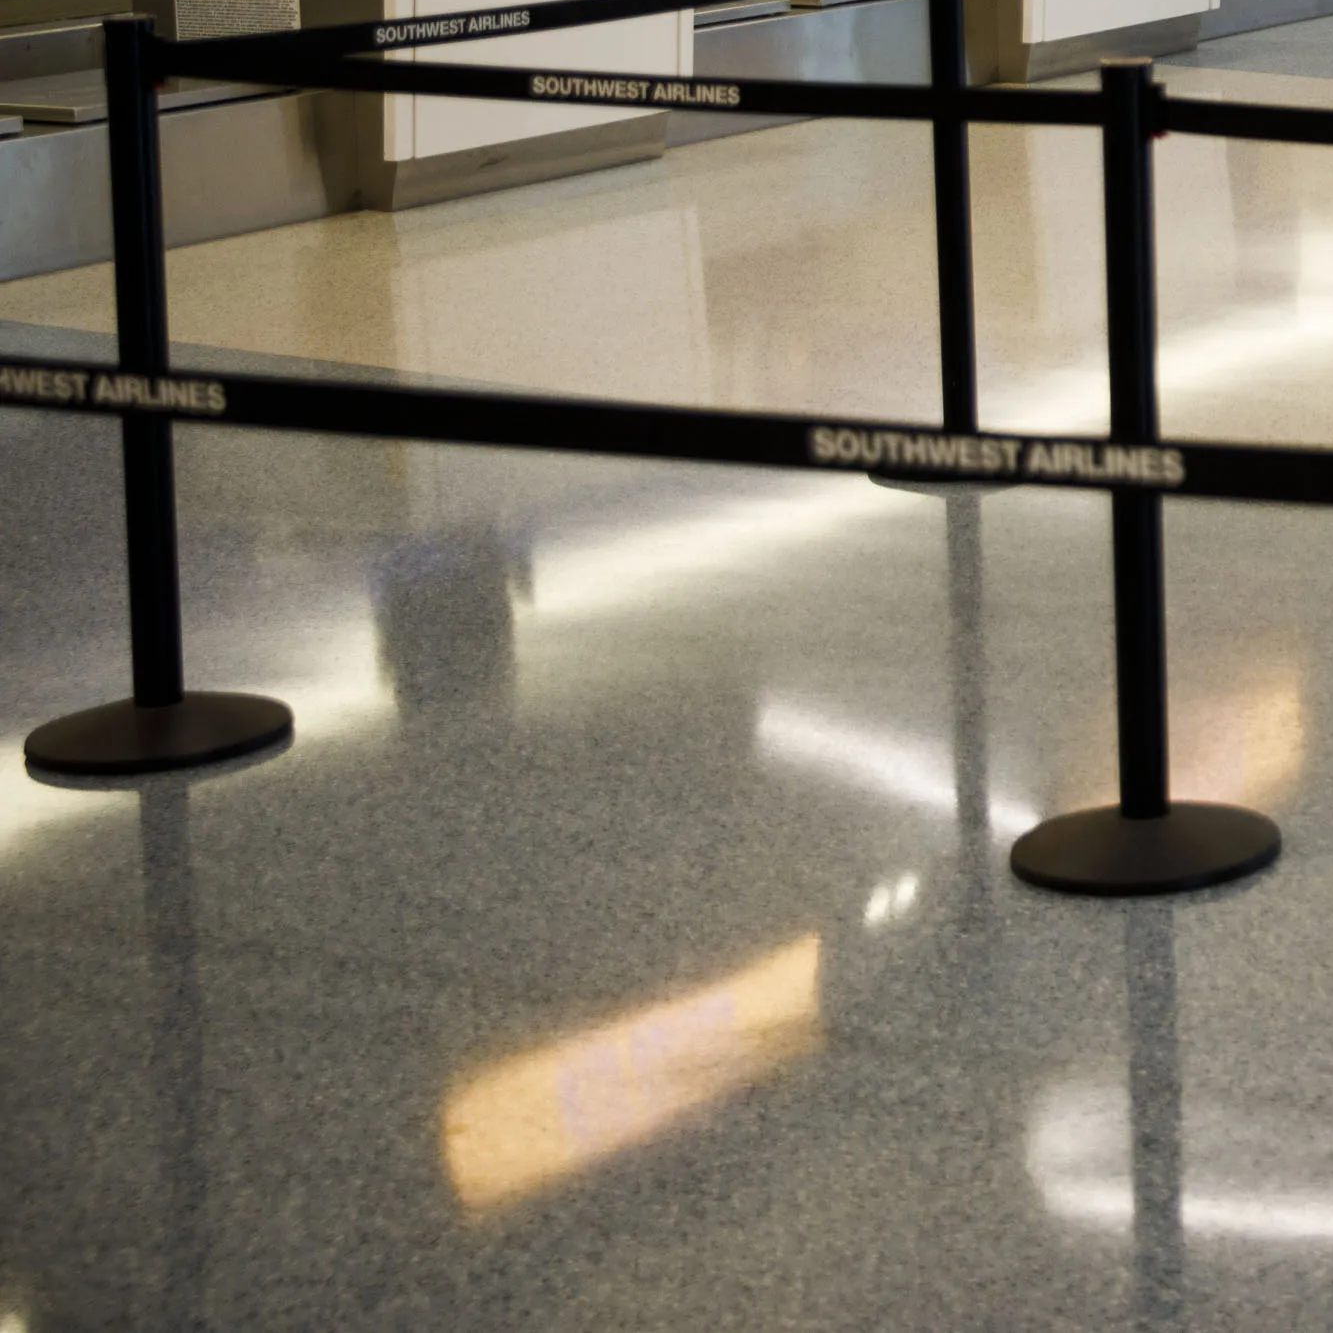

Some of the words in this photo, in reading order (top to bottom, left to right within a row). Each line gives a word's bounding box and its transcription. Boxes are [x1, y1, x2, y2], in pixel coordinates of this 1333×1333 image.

[376, 18, 467, 44] SOUTHWEST
[468, 10, 530, 33] AIRLINES
[532, 74, 650, 100] SOUTHWEST
[653, 82, 741, 105] AIRLINES
[95, 372, 226, 412] AIRLINES
[810, 425, 1022, 472] SOUTHWEST
[1025, 440, 1185, 484] AIRLINES
